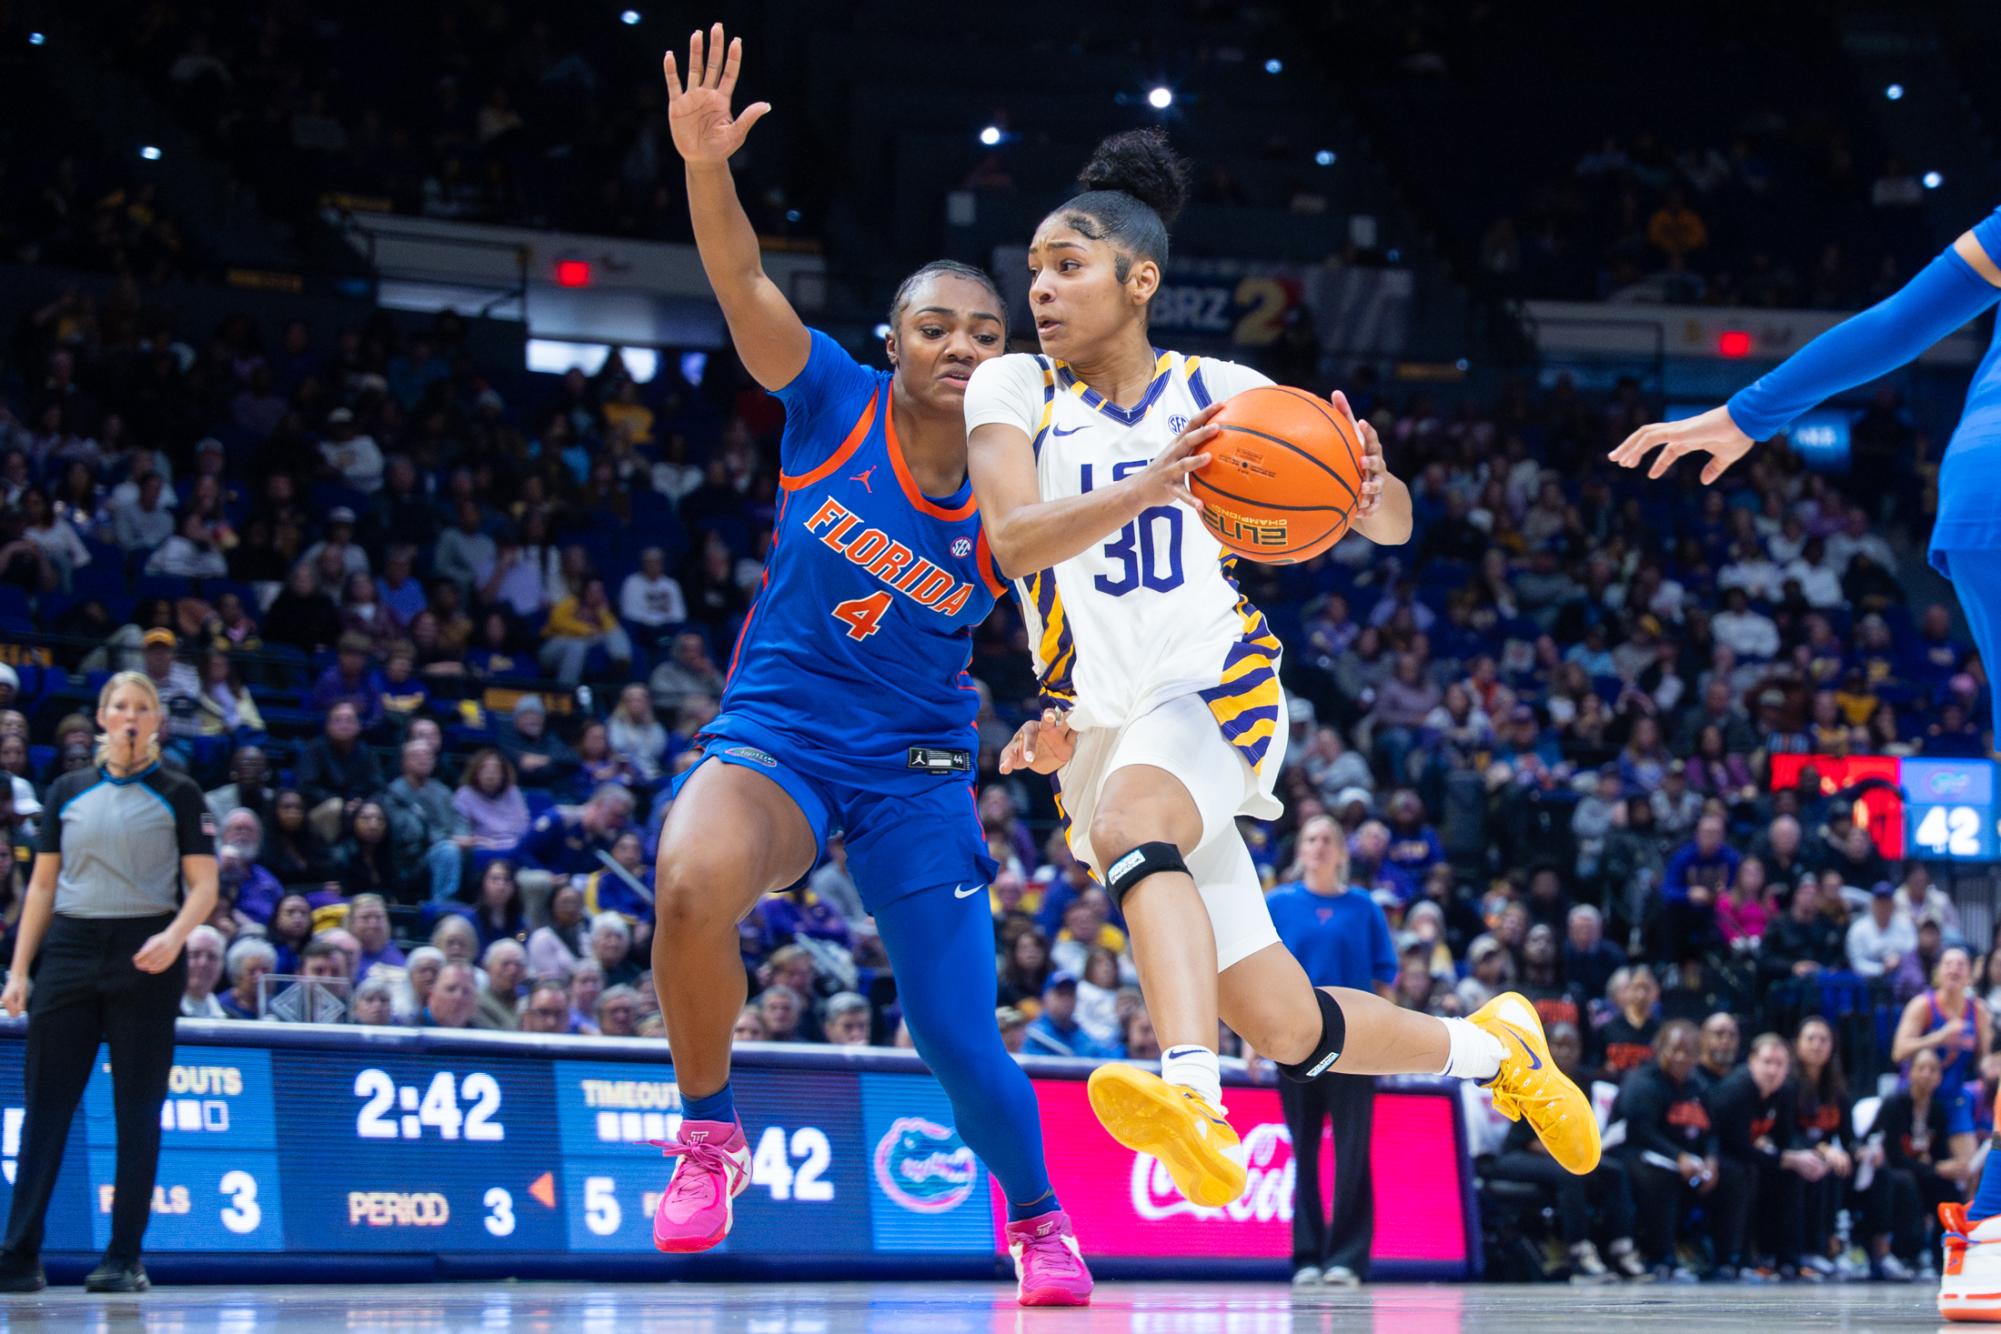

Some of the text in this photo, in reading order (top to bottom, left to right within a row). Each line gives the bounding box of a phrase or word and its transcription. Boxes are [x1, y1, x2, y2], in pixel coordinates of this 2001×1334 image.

[1094, 505, 1185, 597] 30
[1202, 505, 1288, 546] ELITE
[804, 495, 975, 616] FLORIDA
[831, 590, 894, 642] 4
[1915, 805, 1980, 856] 42
[354, 1068, 505, 1140] 2:42
[581, 1079, 682, 1109] TIMEOUT
[751, 1126, 835, 1200] 42
[220, 1170, 262, 1234] 3
[347, 1187, 516, 1236] PERIOD 3
[584, 1176, 622, 1235] 5
